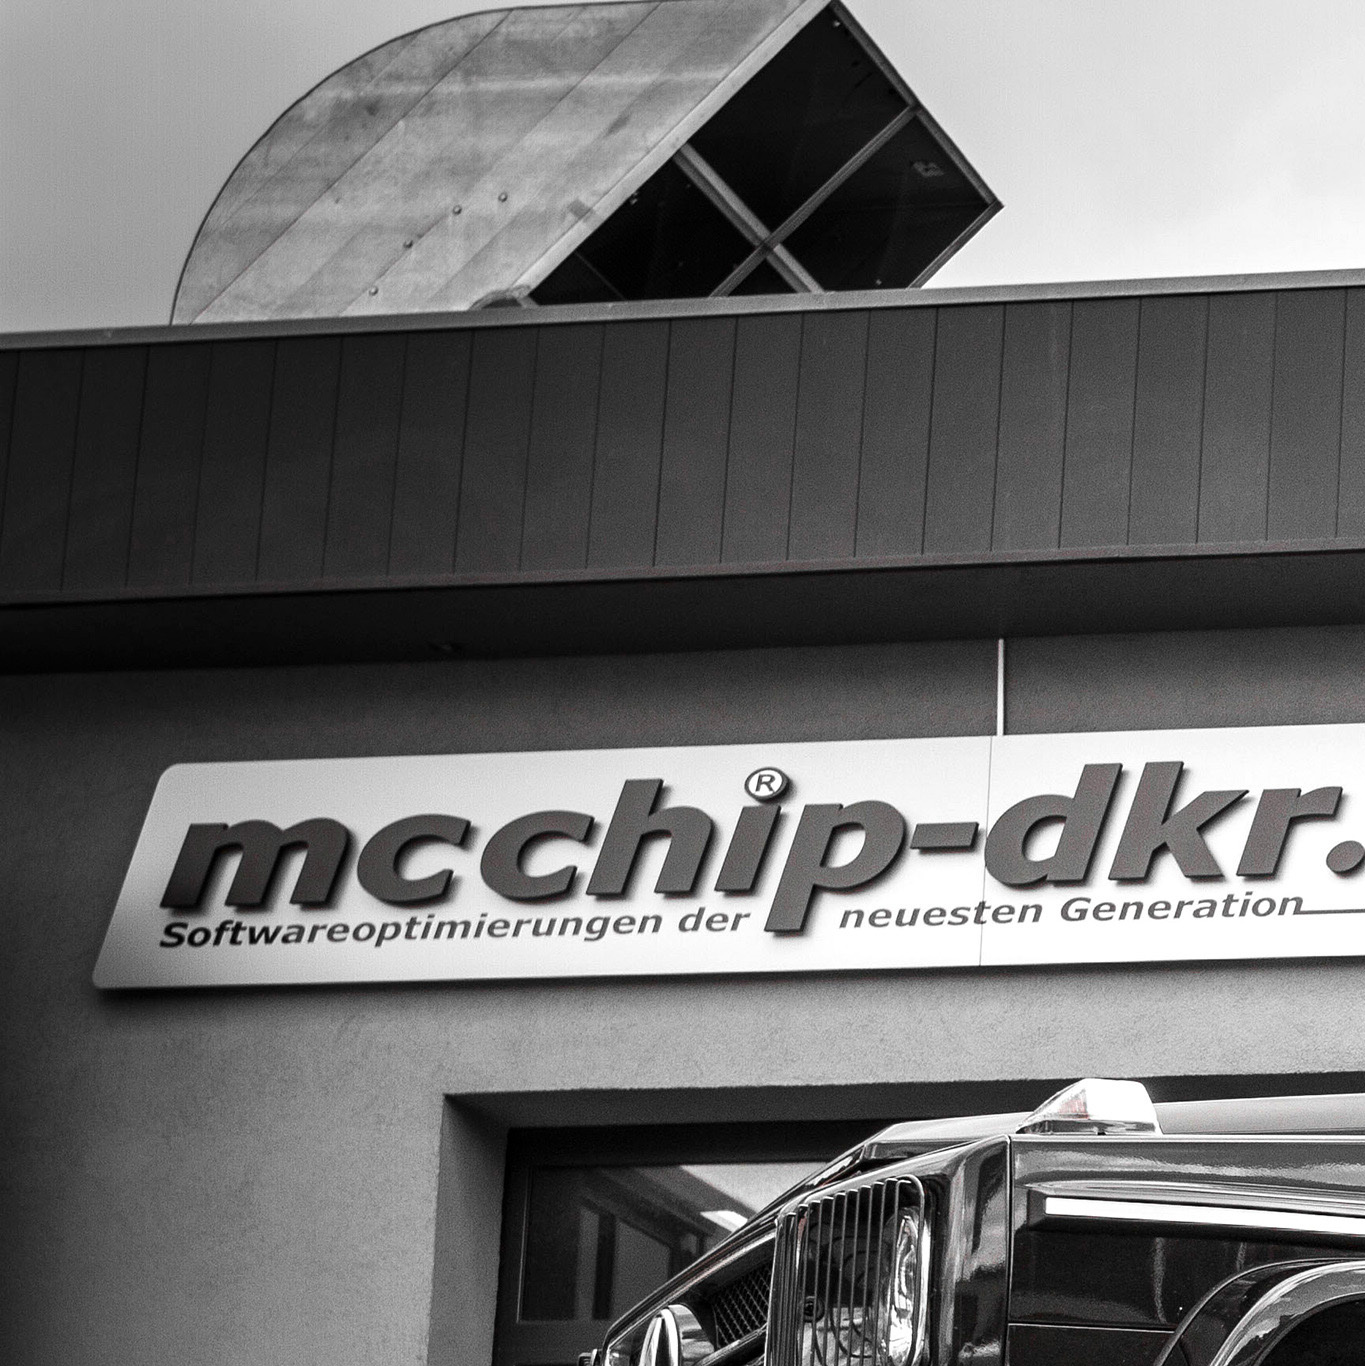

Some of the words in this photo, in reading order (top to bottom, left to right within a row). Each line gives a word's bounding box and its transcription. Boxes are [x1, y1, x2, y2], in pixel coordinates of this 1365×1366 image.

[159, 905, 661, 949] Softwareoptimierungen
[677, 904, 751, 935] der
[839, 897, 1043, 931] neuesten
[1060, 890, 1304, 925] Generation
